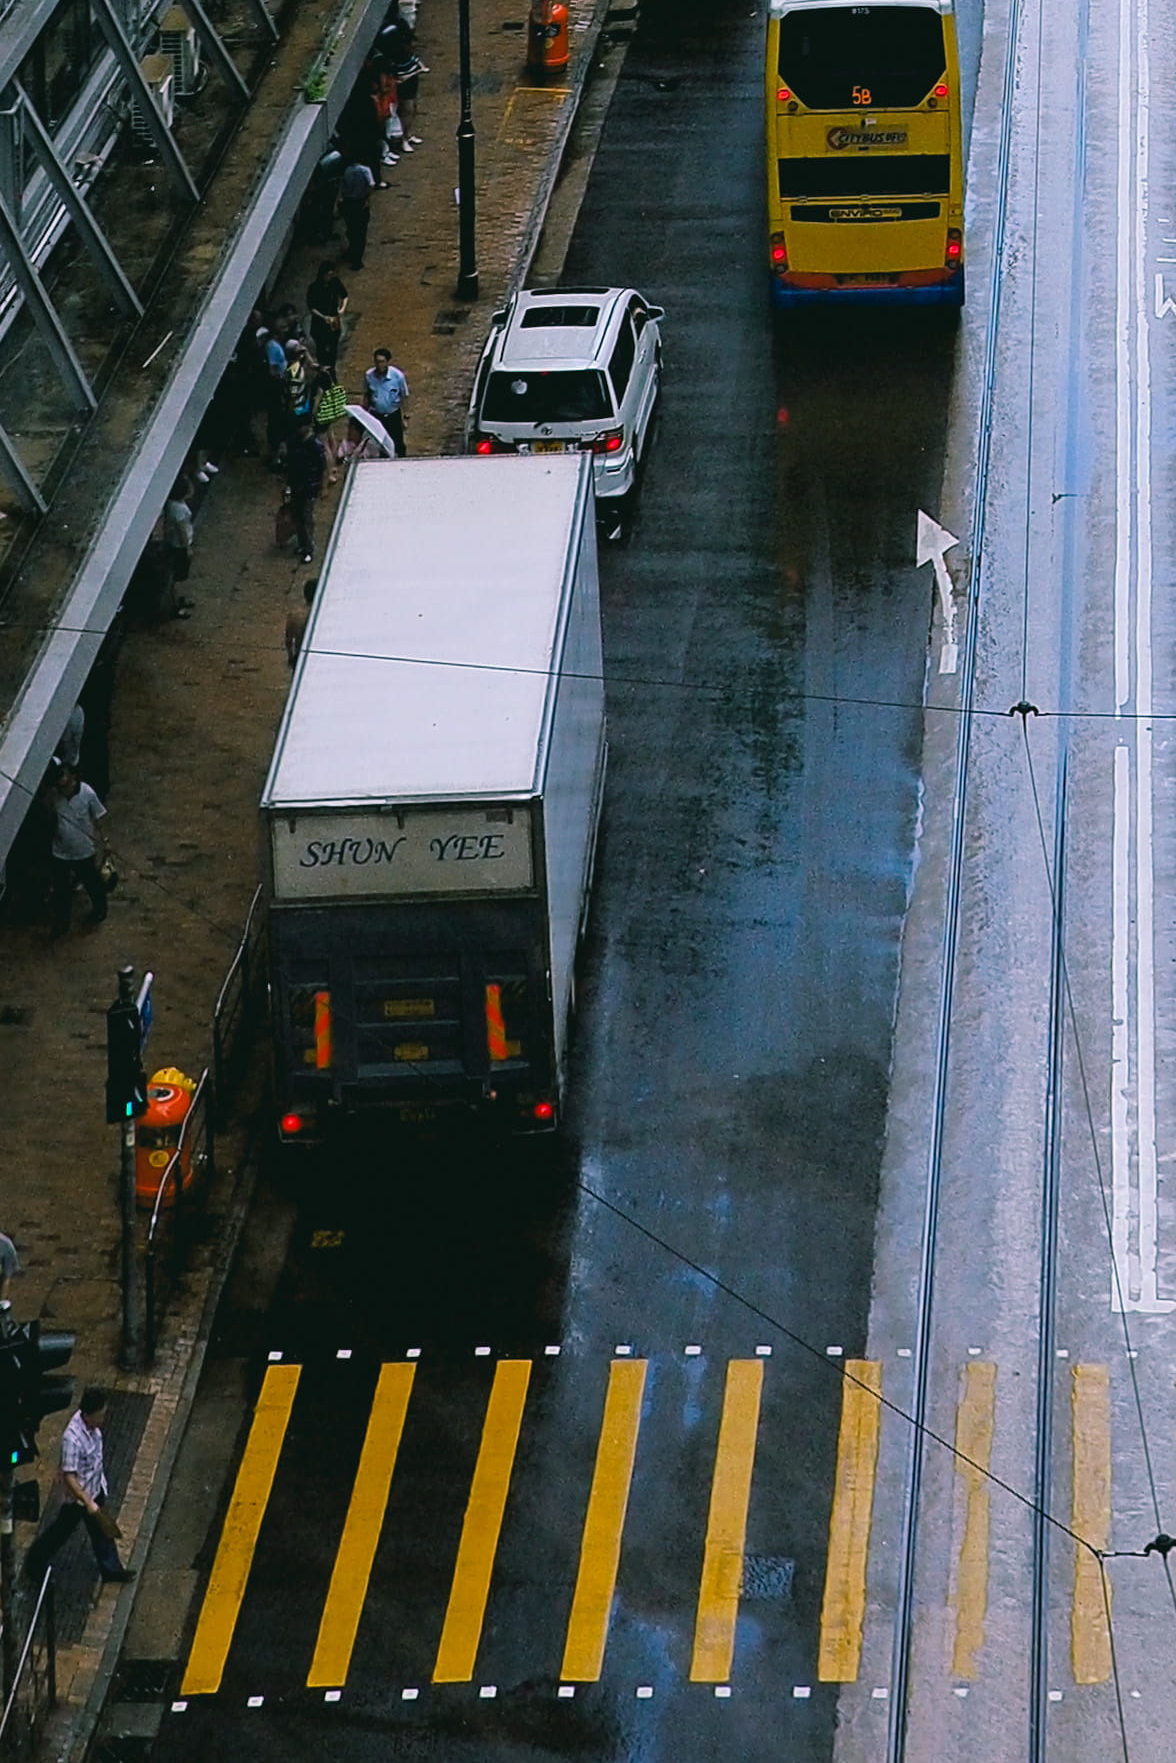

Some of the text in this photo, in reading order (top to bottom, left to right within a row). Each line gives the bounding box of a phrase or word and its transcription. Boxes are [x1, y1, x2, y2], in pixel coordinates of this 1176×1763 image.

[851, 85, 872, 106] 5B
[300, 834, 506, 869] SHUN YEE
